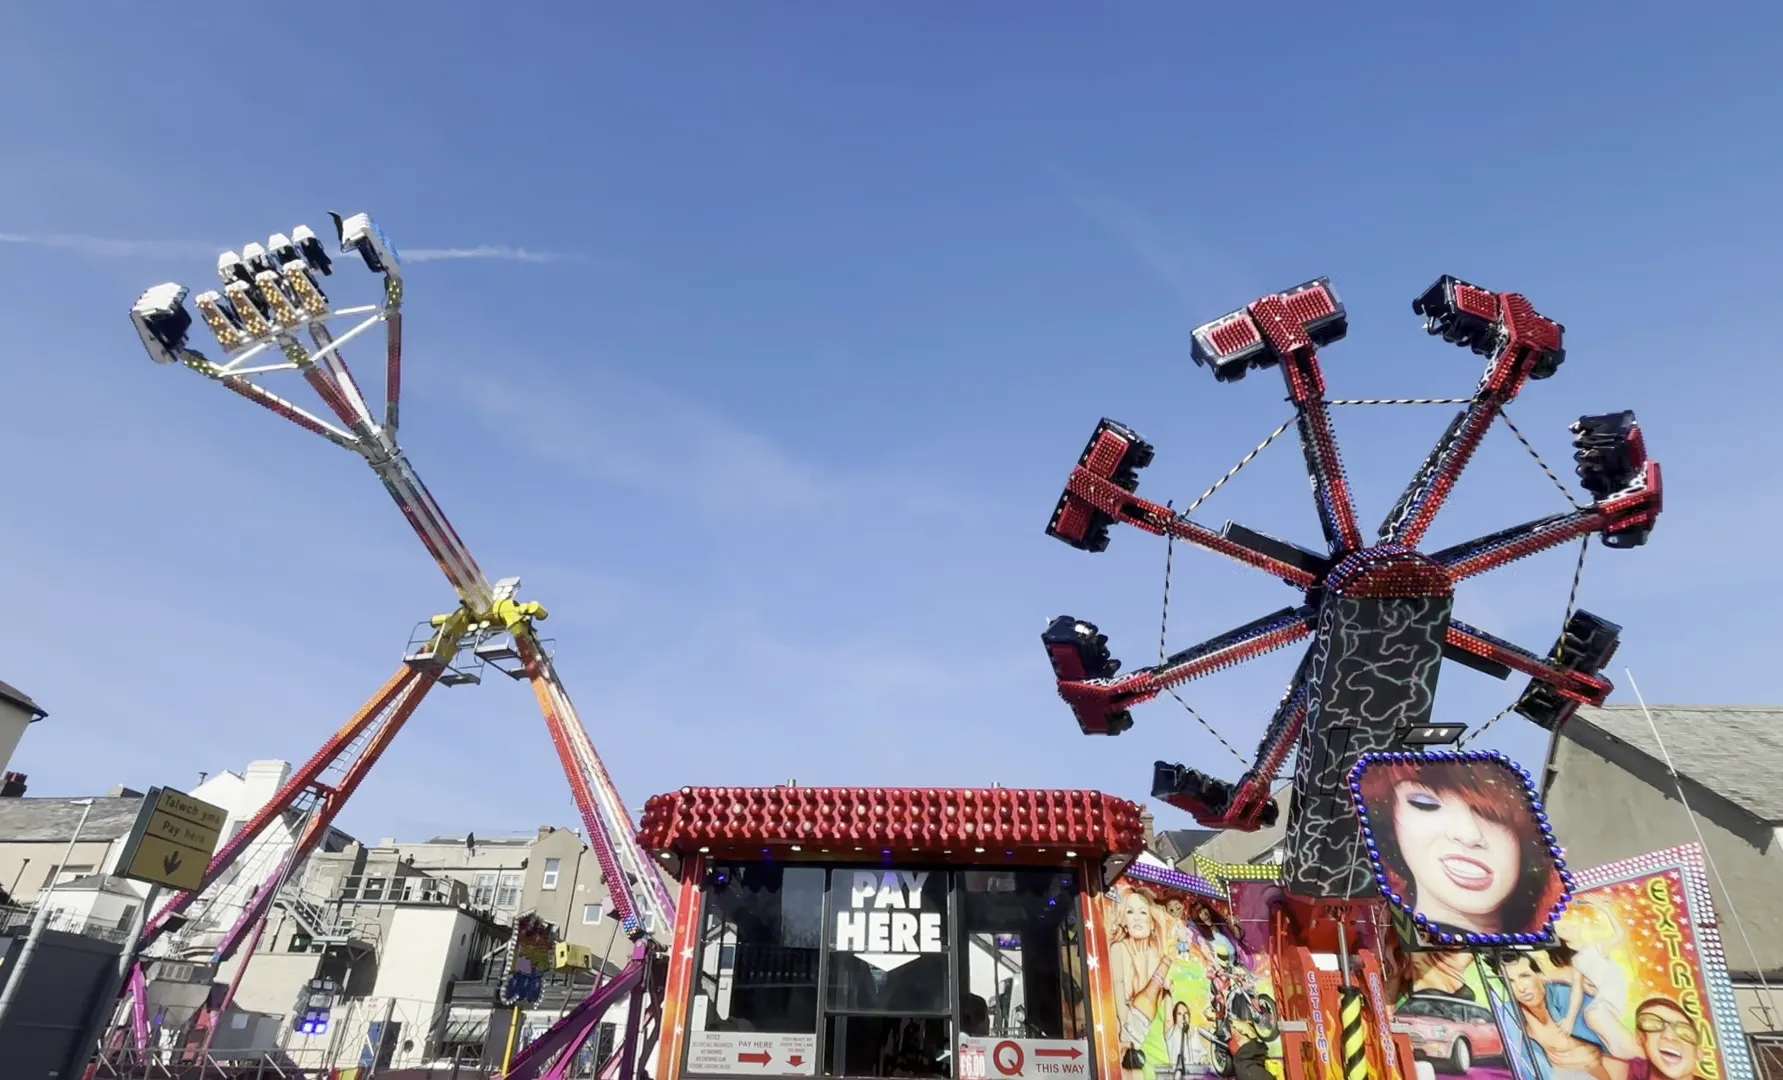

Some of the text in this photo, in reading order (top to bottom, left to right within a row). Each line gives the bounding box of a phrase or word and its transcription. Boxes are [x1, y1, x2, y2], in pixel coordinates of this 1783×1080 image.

[165, 794, 198, 816] Talwch
[162, 820, 206, 843] Pay here
[852, 871, 929, 909] PAY
[836, 911, 942, 952] HERE
[1307, 970, 1329, 1063] EXTREME
[738, 1040, 752, 1048] PAY
[753, 1041, 773, 1049] HERE
[960, 1054, 986, 1078] £6.00
[993, 1040, 1025, 1077] Q
[1036, 1063, 1085, 1074] THIS WAY
